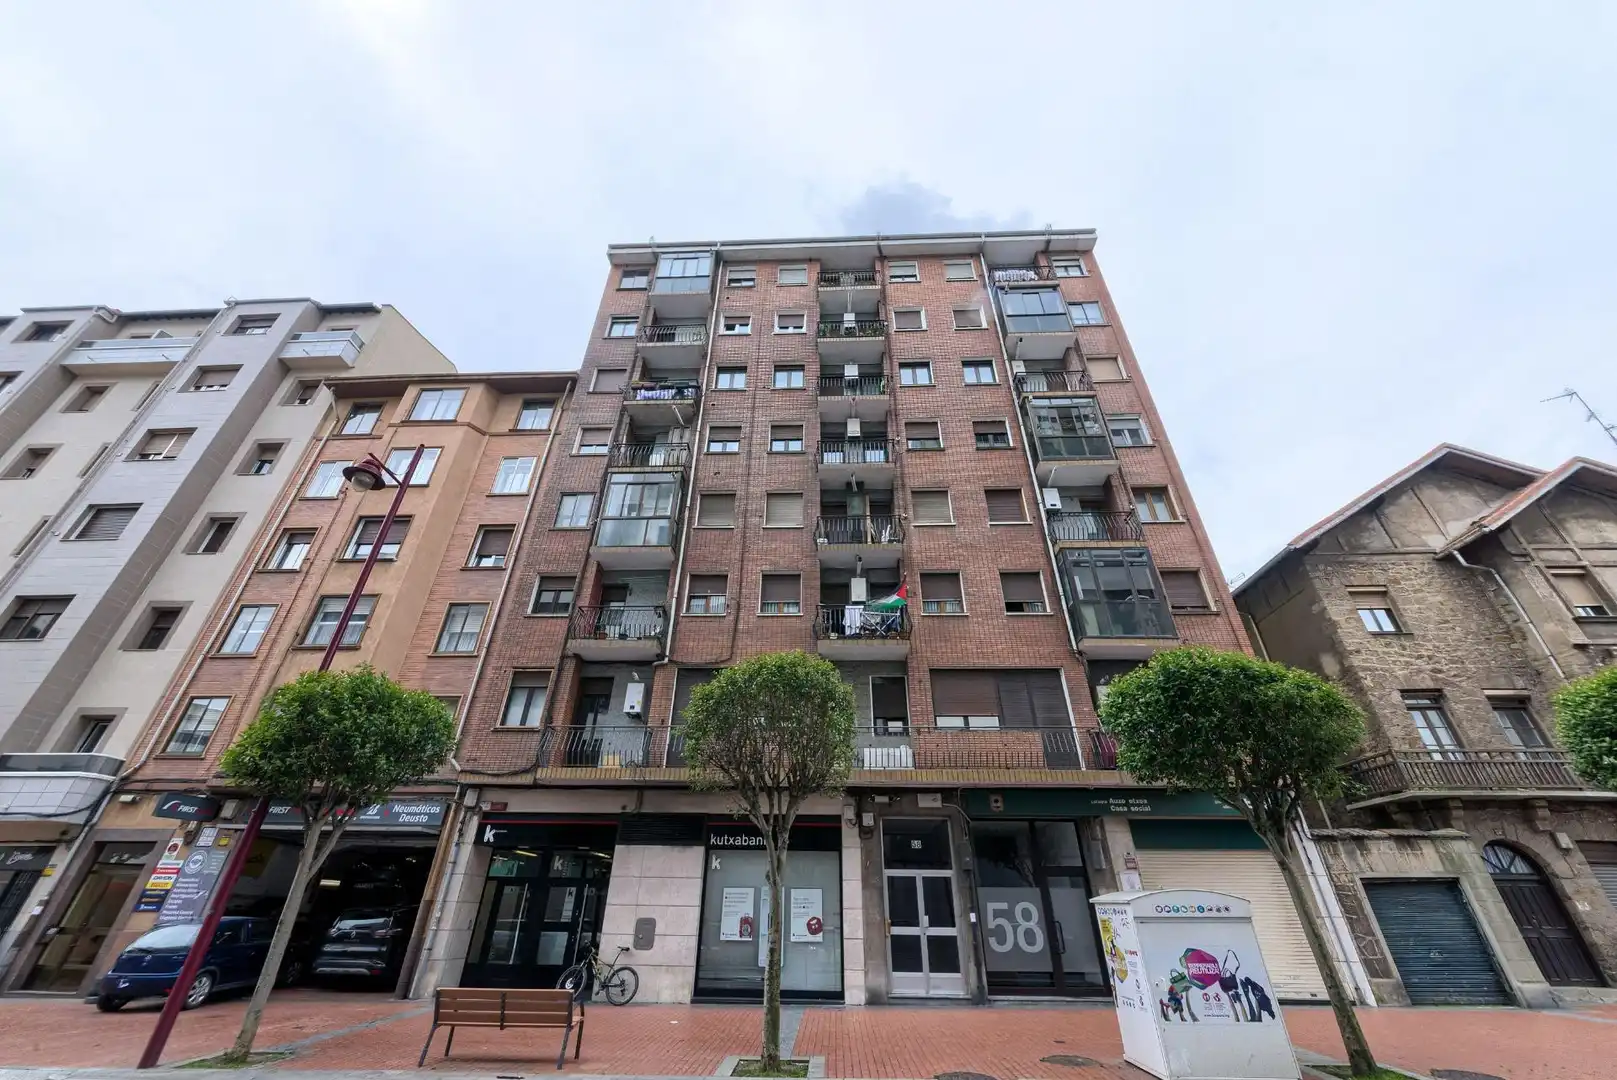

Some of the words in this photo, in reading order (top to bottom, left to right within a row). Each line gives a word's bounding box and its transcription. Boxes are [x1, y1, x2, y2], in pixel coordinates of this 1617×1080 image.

[178, 804, 199, 814] FIRST
[269, 806, 292, 814] FIRST
[392, 804, 441, 814] Neumáticos
[398, 813, 429, 823] Deusto
[911, 840, 922, 848] 58
[986, 901, 1044, 953] 58
